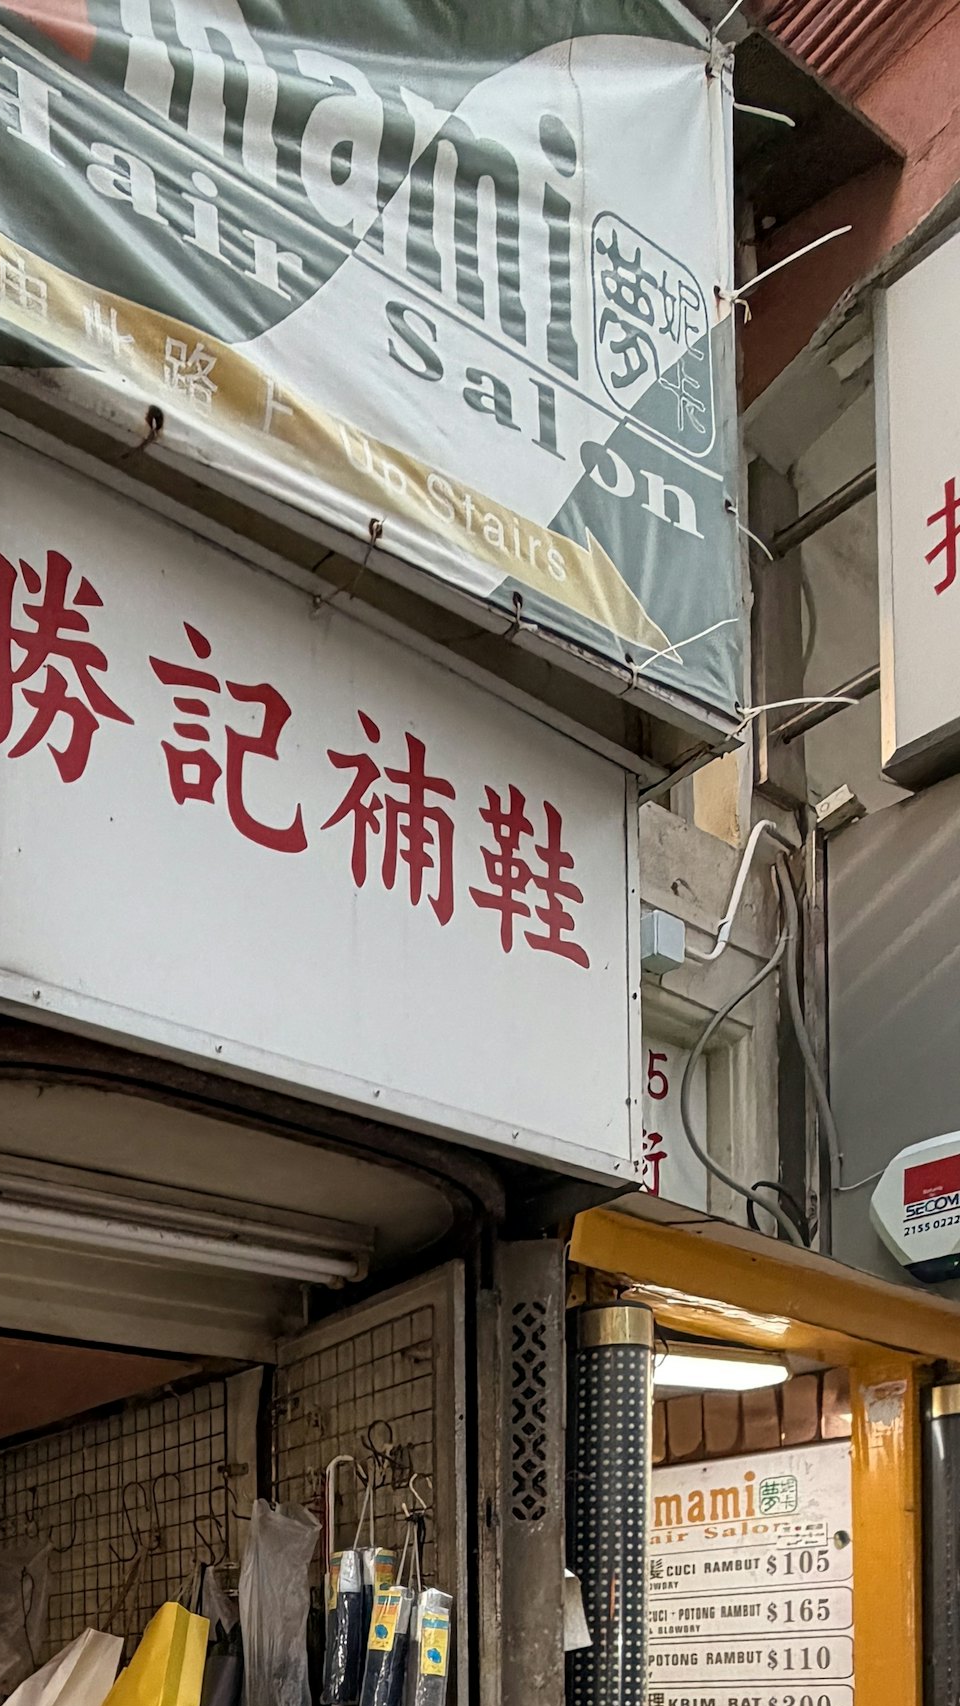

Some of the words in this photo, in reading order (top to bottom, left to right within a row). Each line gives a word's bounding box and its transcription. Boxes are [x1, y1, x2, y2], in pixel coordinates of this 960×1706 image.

[385, 299, 706, 541] Salon
[338, 422, 411, 502] Up
[425, 471, 568, 582] Stairs
[905, 1193, 959, 1218] SECOM
[903, 1221, 931, 1237] 2155
[932, 1215, 960, 1229] 0222
[654, 1470, 756, 1527] mami
[666, 1564, 696, 1577] CUCI
[704, 1557, 761, 1574] RAMBUT
[766, 1549, 830, 1576] $105
[678, 1606, 716, 1621] POTONG
[720, 1603, 761, 1618] RAMBUT
[767, 1598, 831, 1624] $165
[648, 1652, 699, 1667] POTONG
[706, 1650, 763, 1666] RAMBUT
[767, 1645, 831, 1671] $110
